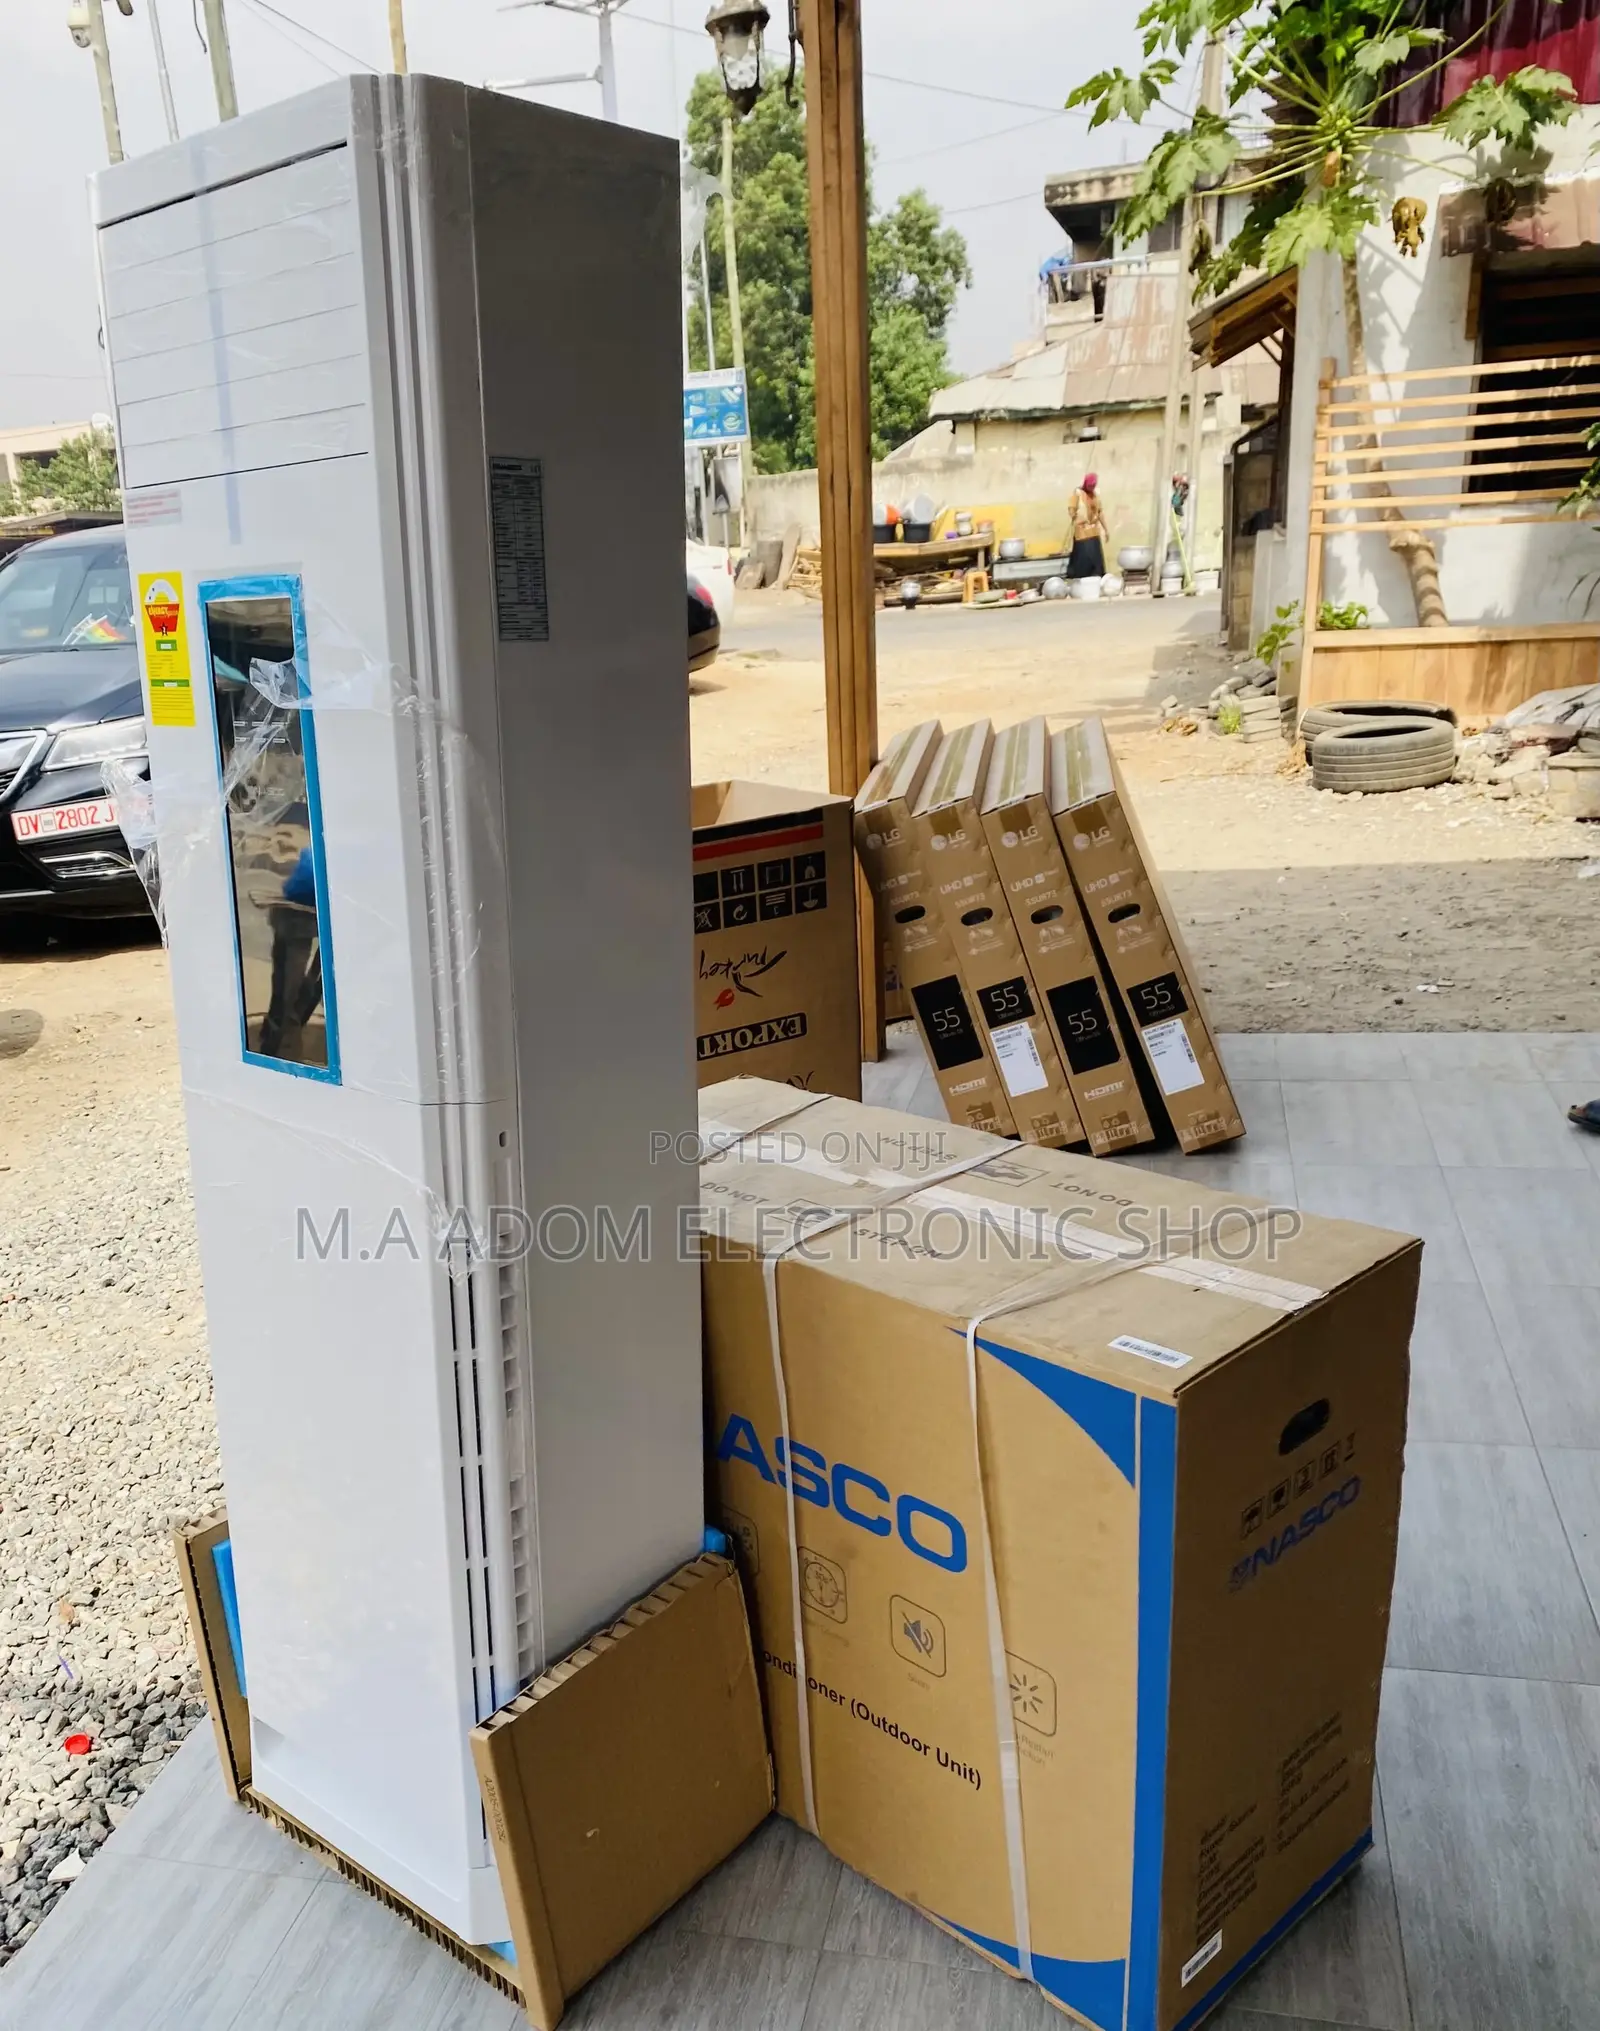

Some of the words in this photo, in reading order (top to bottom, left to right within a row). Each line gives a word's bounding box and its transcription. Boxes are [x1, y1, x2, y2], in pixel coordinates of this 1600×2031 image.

[17, 814, 41, 836] DV
[55, 805, 100, 830] 2802
[882, 828, 901, 843] LG
[947, 829, 966, 844] LG
[1019, 825, 1038, 841] LG
[1090, 826, 1110, 841] LG
[940, 880, 962, 895] UHD
[1011, 877, 1034, 892] UHD
[1084, 878, 1108, 893] UHD
[990, 986, 1020, 1012] 55
[1140, 982, 1171, 1009] 55
[932, 1007, 961, 1032] 55
[1067, 1008, 1097, 1035] 55
[699, 1015, 803, 1059] EXPORT
[700, 1181, 728, 1193] DO
[729, 1188, 770, 1205] NOT
[1051, 1181, 1099, 1197] NOT
[1099, 1193, 1134, 1207] DO
[716, 1413, 968, 1573] ASCO
[1252, 1475, 1362, 1577] NASCO
[763, 1650, 846, 1706] ondioner
[850, 1698, 931, 1756] (Outdoor
[936, 1747, 982, 1791] Unit)
